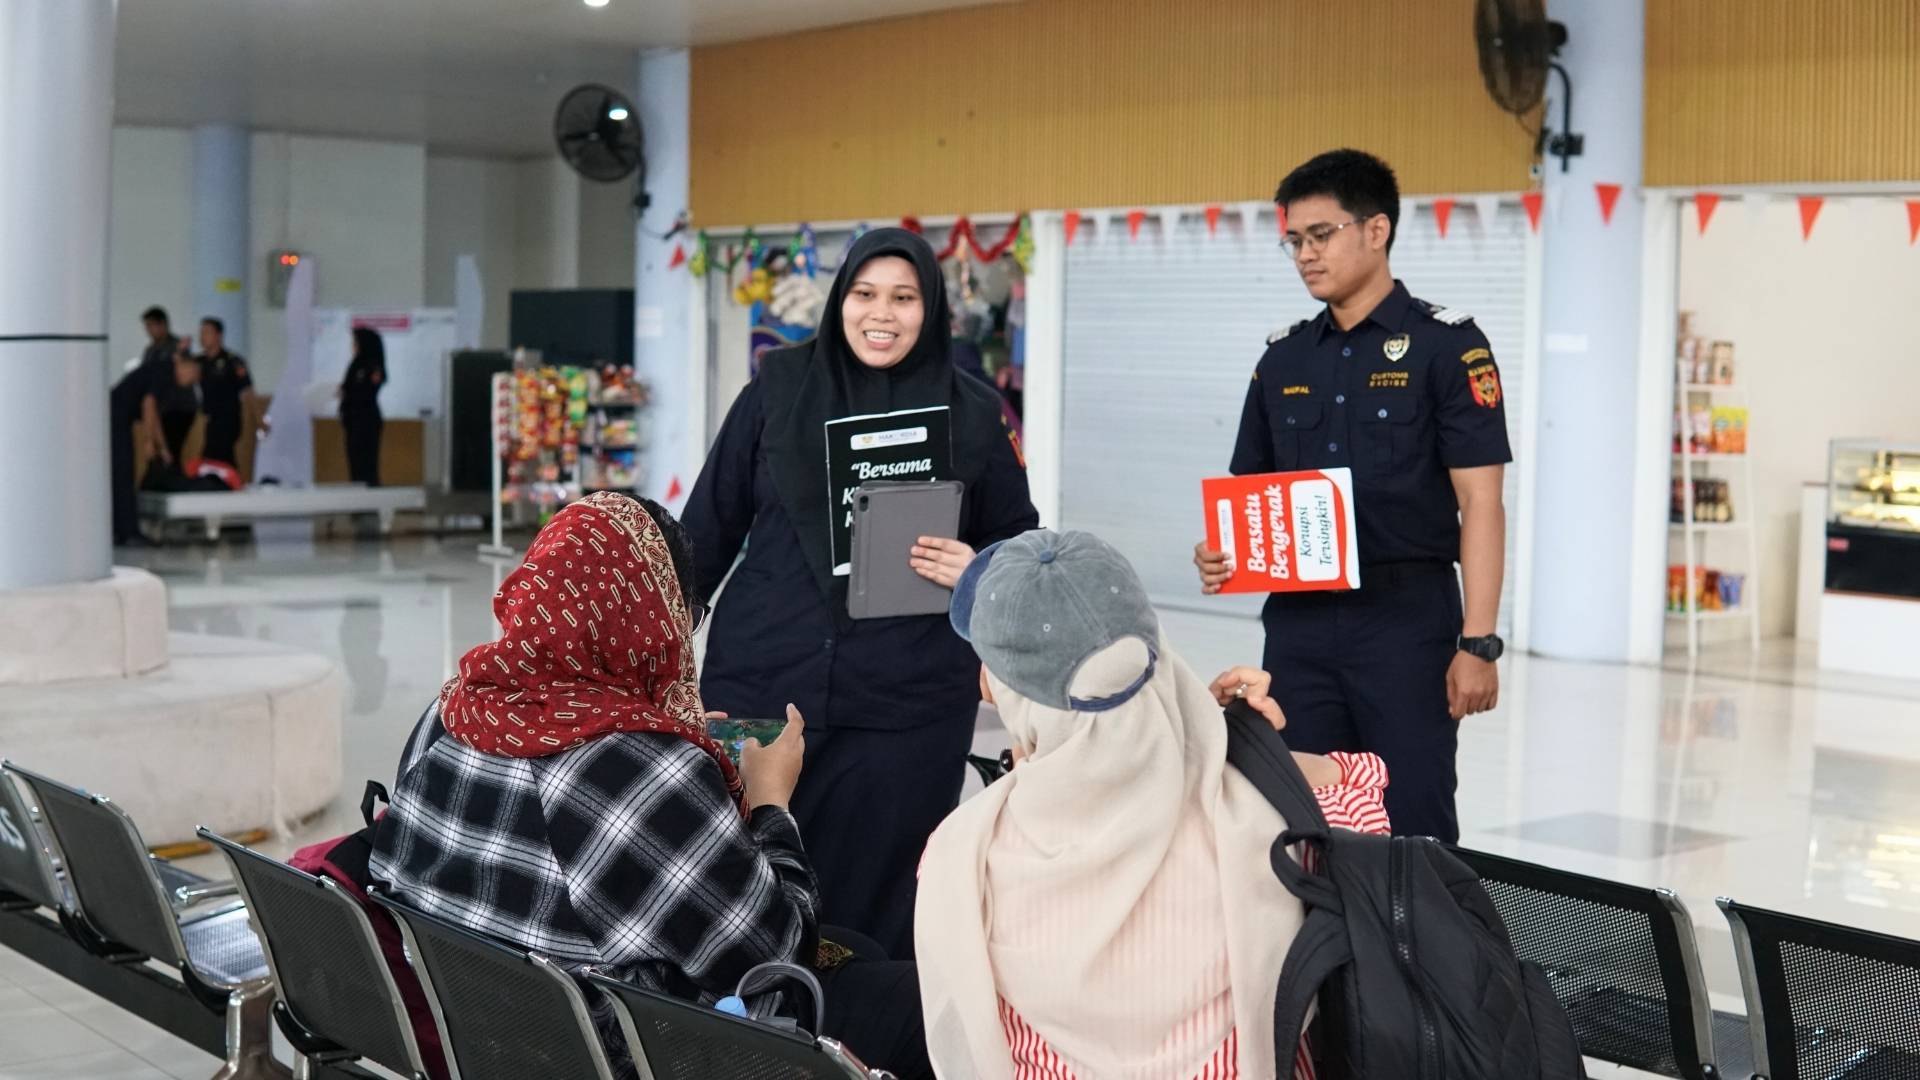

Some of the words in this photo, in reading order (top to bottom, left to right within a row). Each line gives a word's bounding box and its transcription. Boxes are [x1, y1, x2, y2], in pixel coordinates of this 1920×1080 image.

[1244, 492, 1267, 573] Bersatu
[1264, 484, 1290, 580] Bergerak
[1296, 506, 1312, 557] Korupsi
[1314, 495, 1333, 566] Tersingkir!
